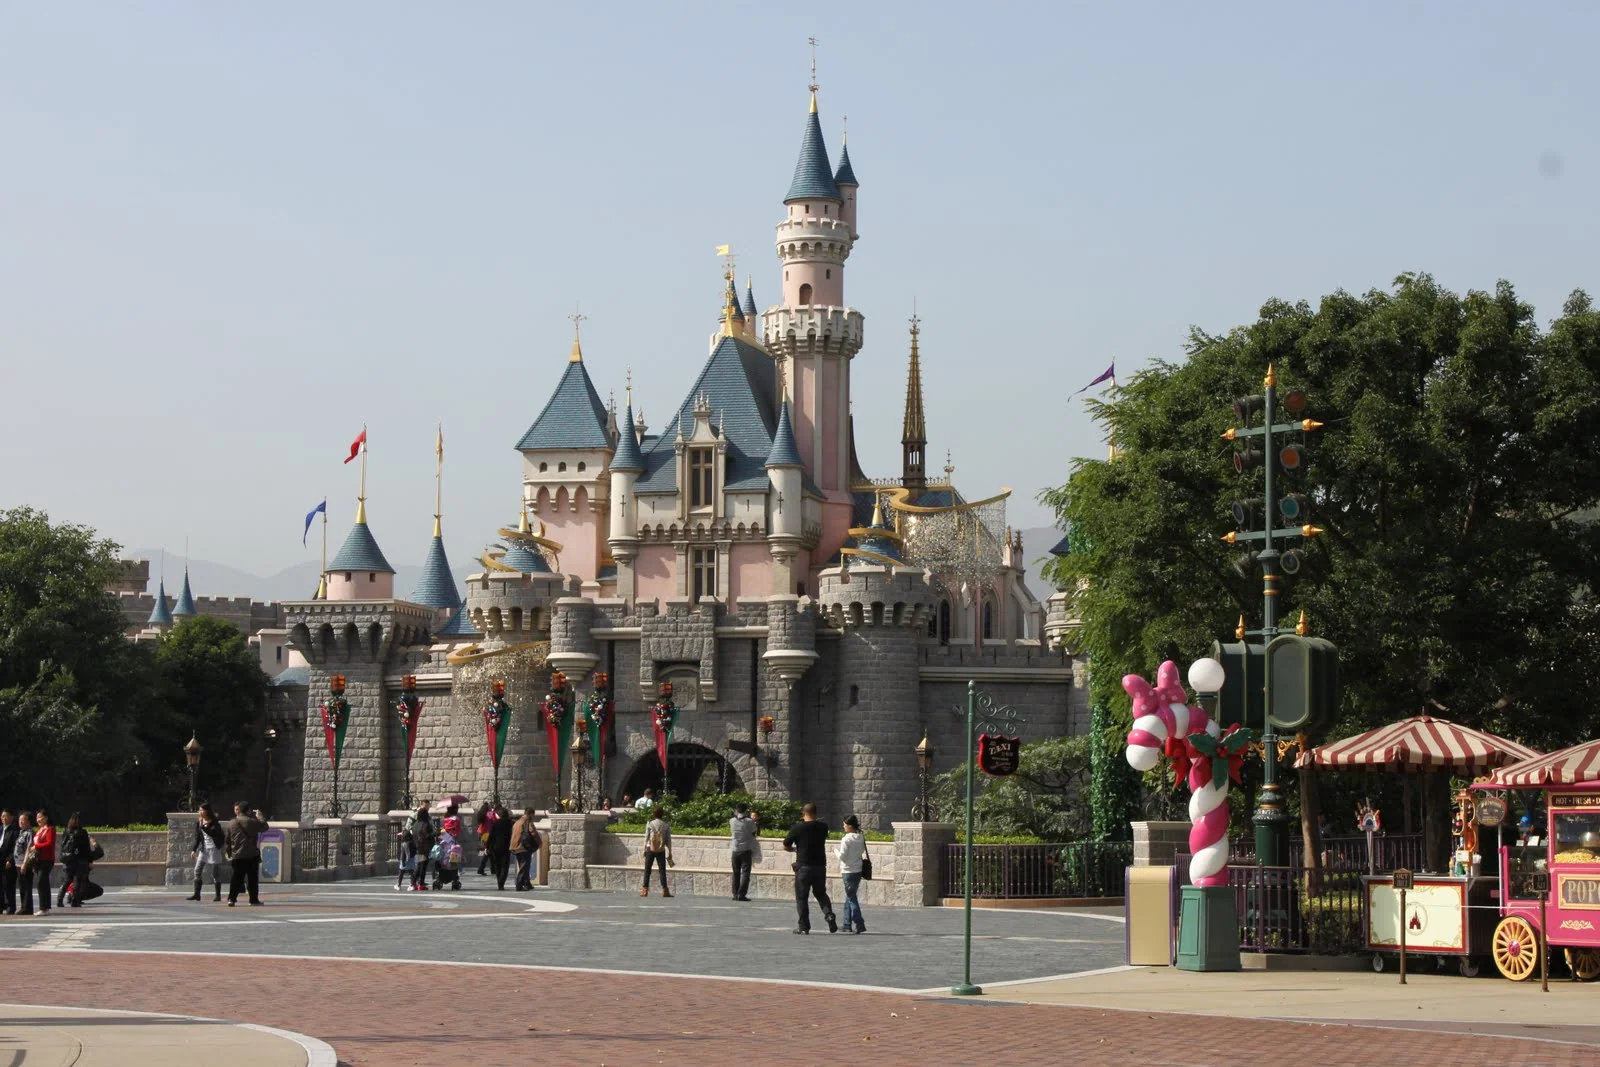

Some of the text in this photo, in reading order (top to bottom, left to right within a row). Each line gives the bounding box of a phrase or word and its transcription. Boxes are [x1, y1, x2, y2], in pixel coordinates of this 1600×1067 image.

[988, 743, 1011, 755] TAXI
[1555, 797, 1567, 805] HOT
[1572, 797, 1592, 805] FRESH
